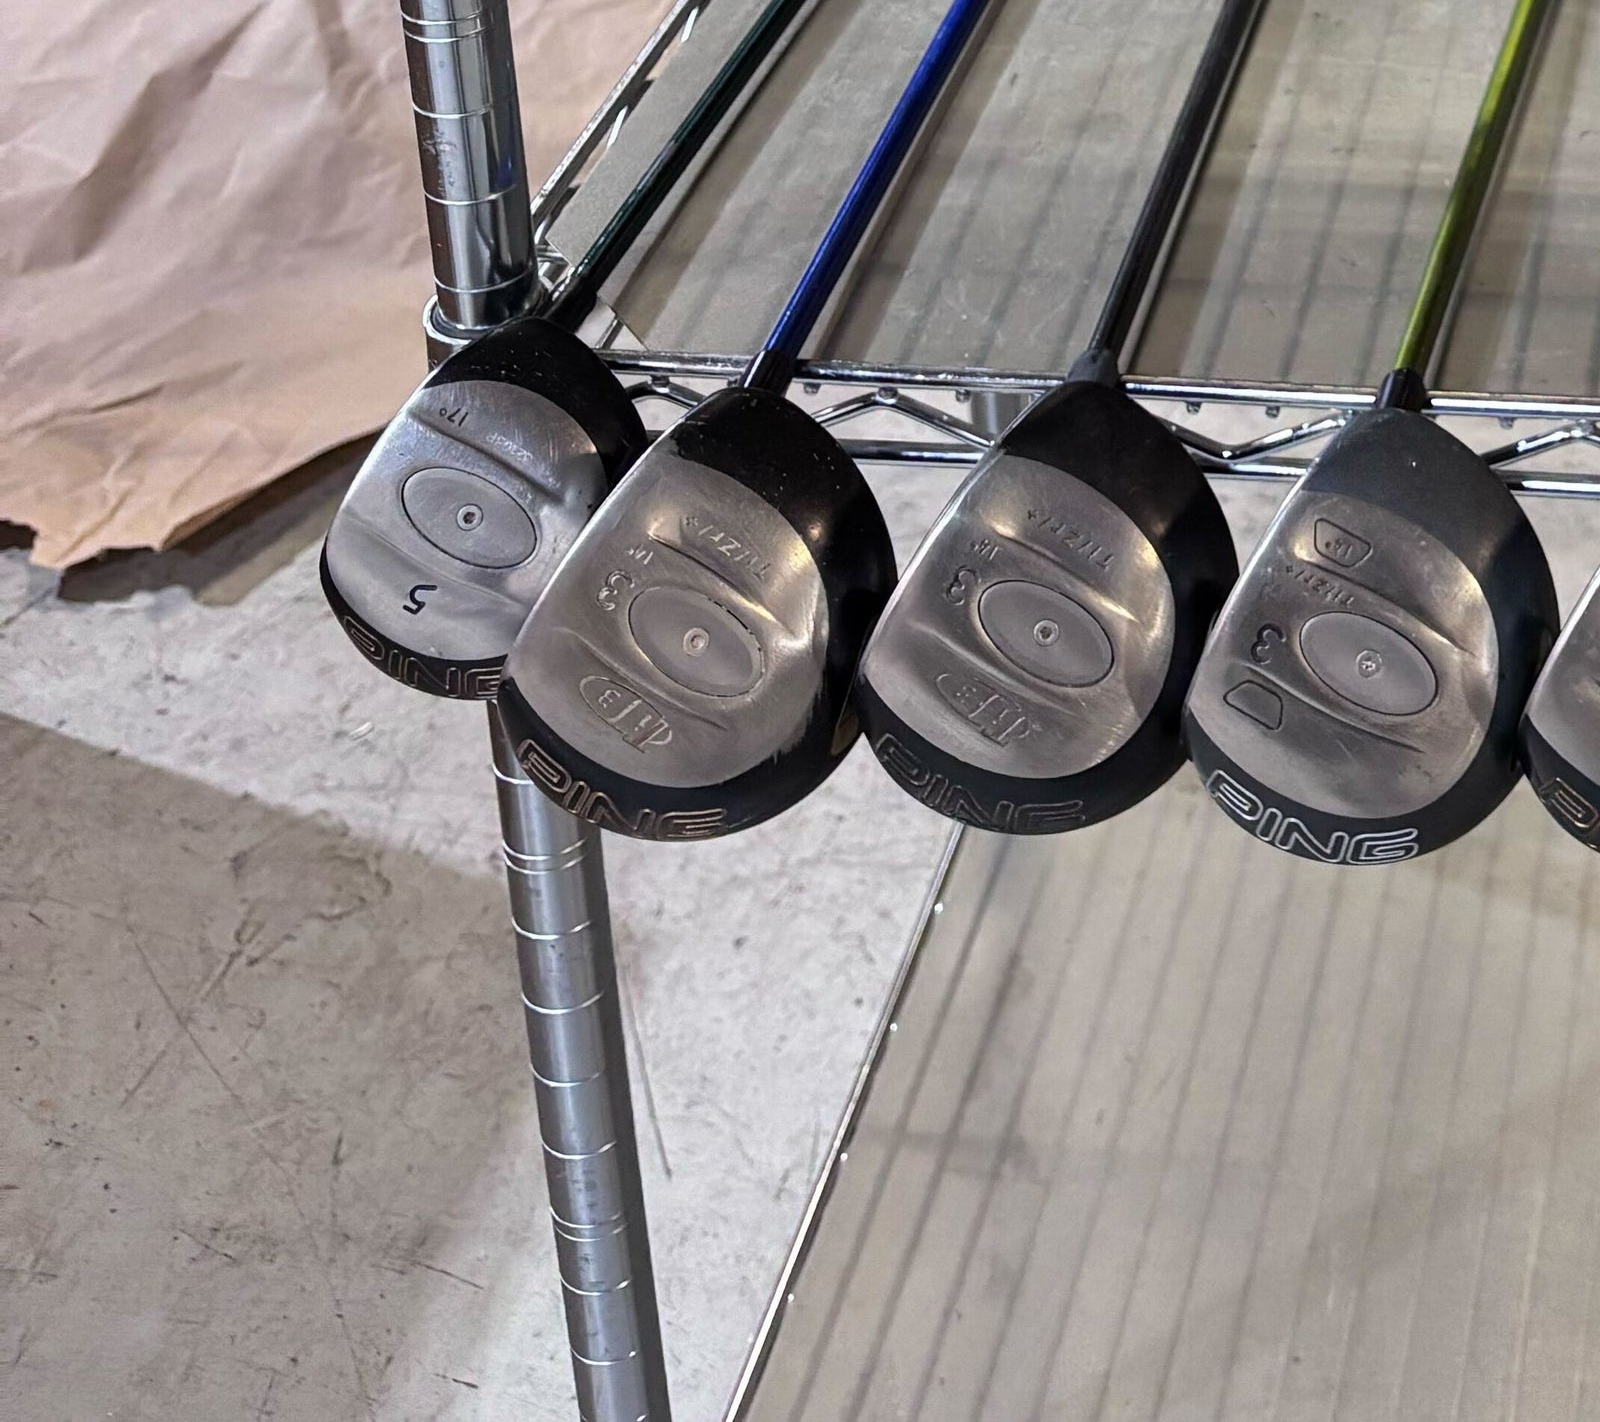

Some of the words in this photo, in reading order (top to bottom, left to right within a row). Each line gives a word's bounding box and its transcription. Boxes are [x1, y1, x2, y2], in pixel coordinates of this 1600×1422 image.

[401, 579, 438, 614] 5
[593, 565, 637, 613] 3
[940, 561, 978, 608] 3
[1247, 621, 1287, 666] 3
[519, 738, 727, 841] PING
[876, 733, 1086, 832] PING
[1206, 767, 1420, 866] PING
